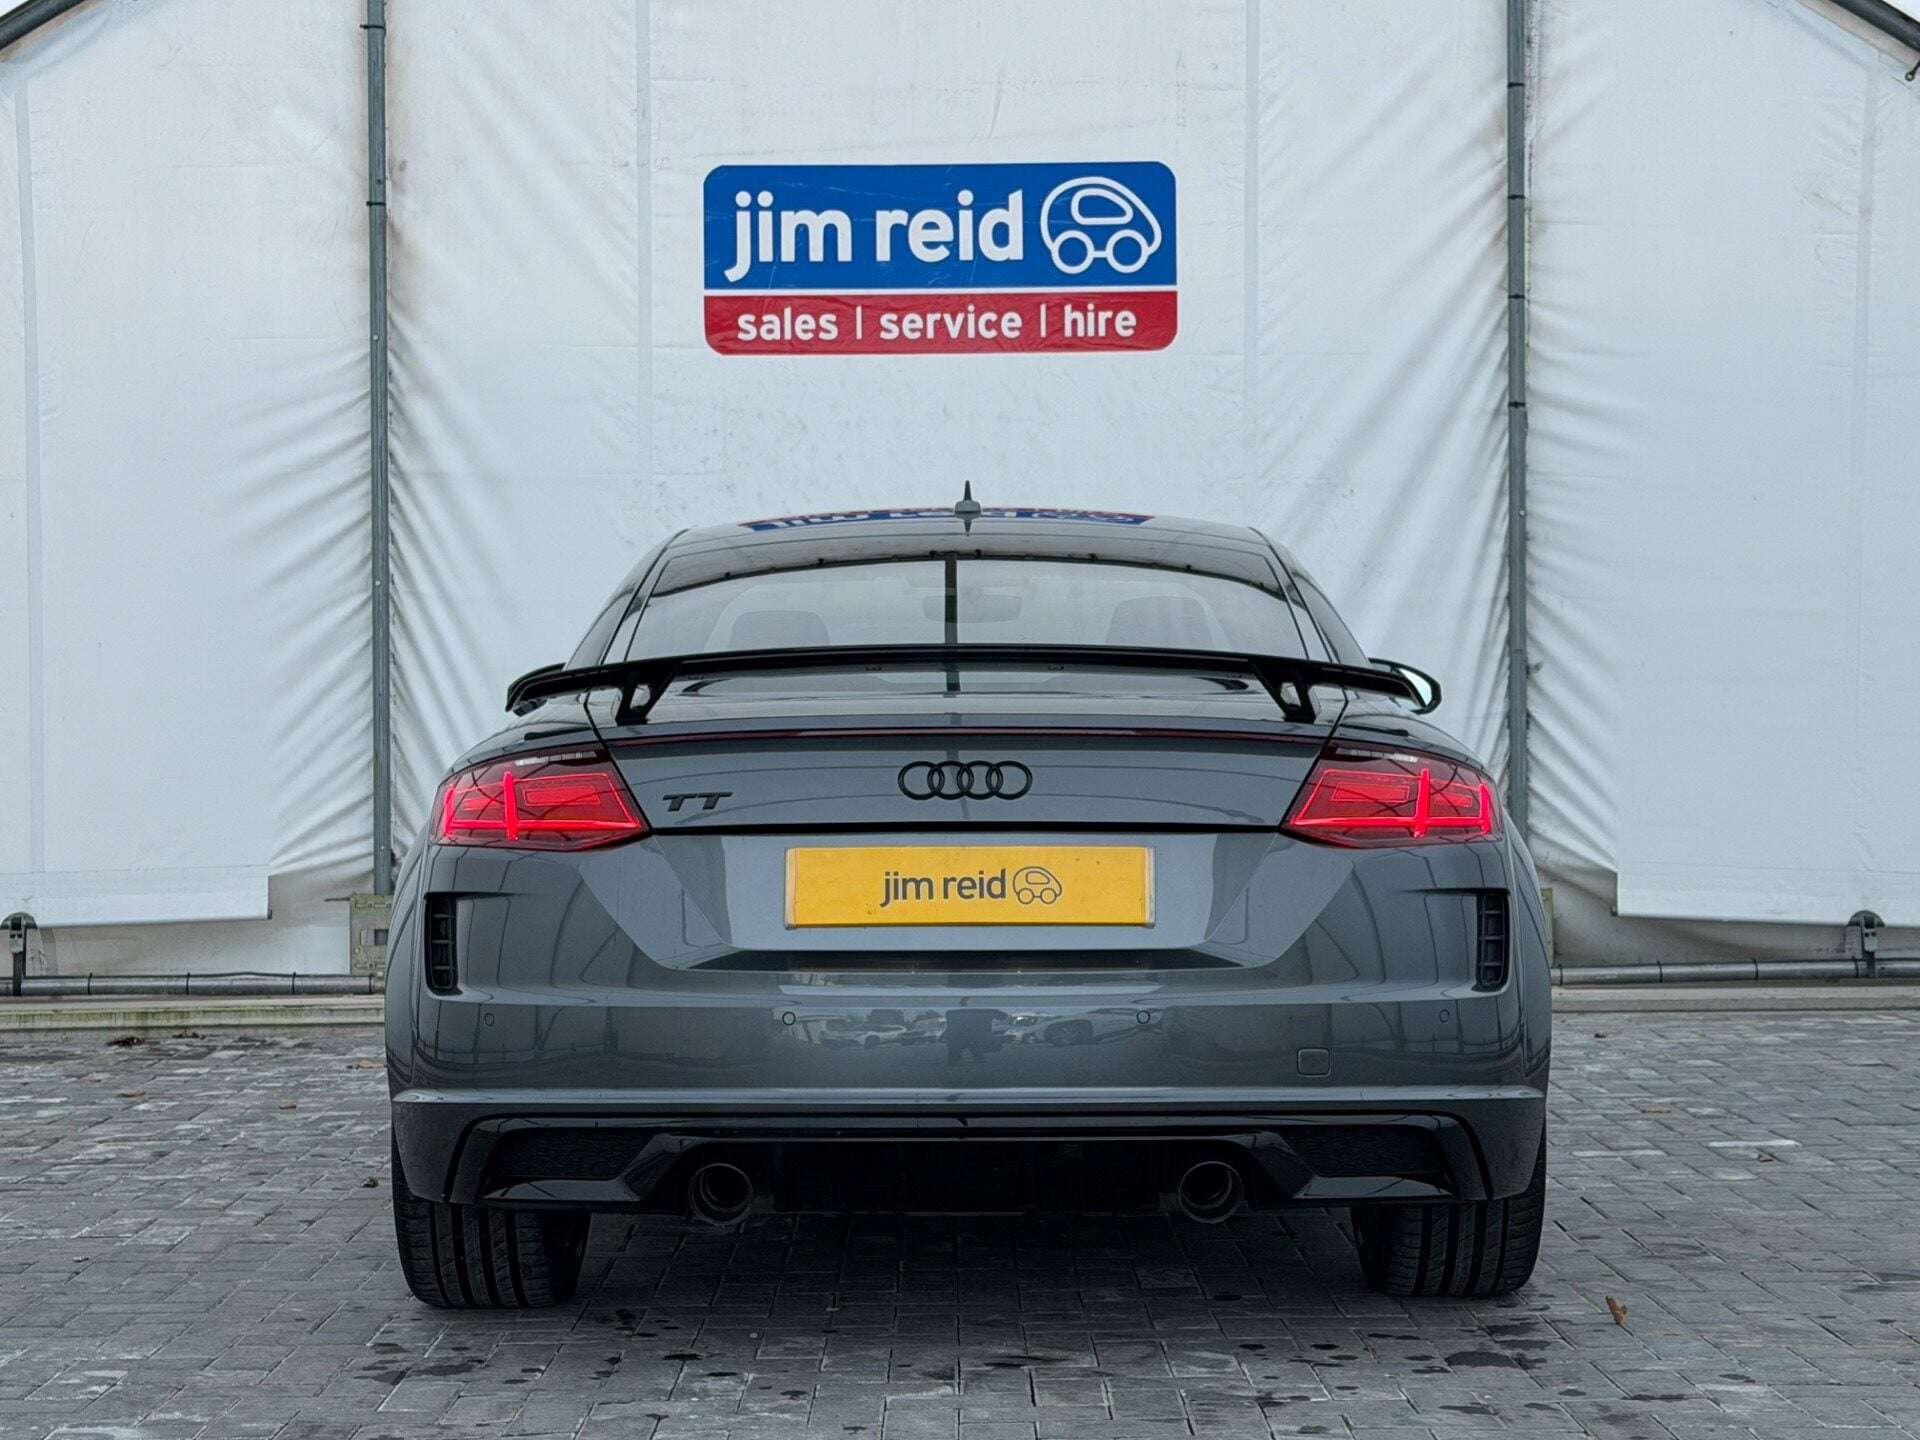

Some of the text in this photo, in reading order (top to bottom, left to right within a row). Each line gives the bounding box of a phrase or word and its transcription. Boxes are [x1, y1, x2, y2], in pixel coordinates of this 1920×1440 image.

[724, 189, 1024, 282] jim reid
[737, 303, 1137, 341] sales service hire
[662, 792, 733, 812] TT
[879, 868, 1007, 908] jim reid
